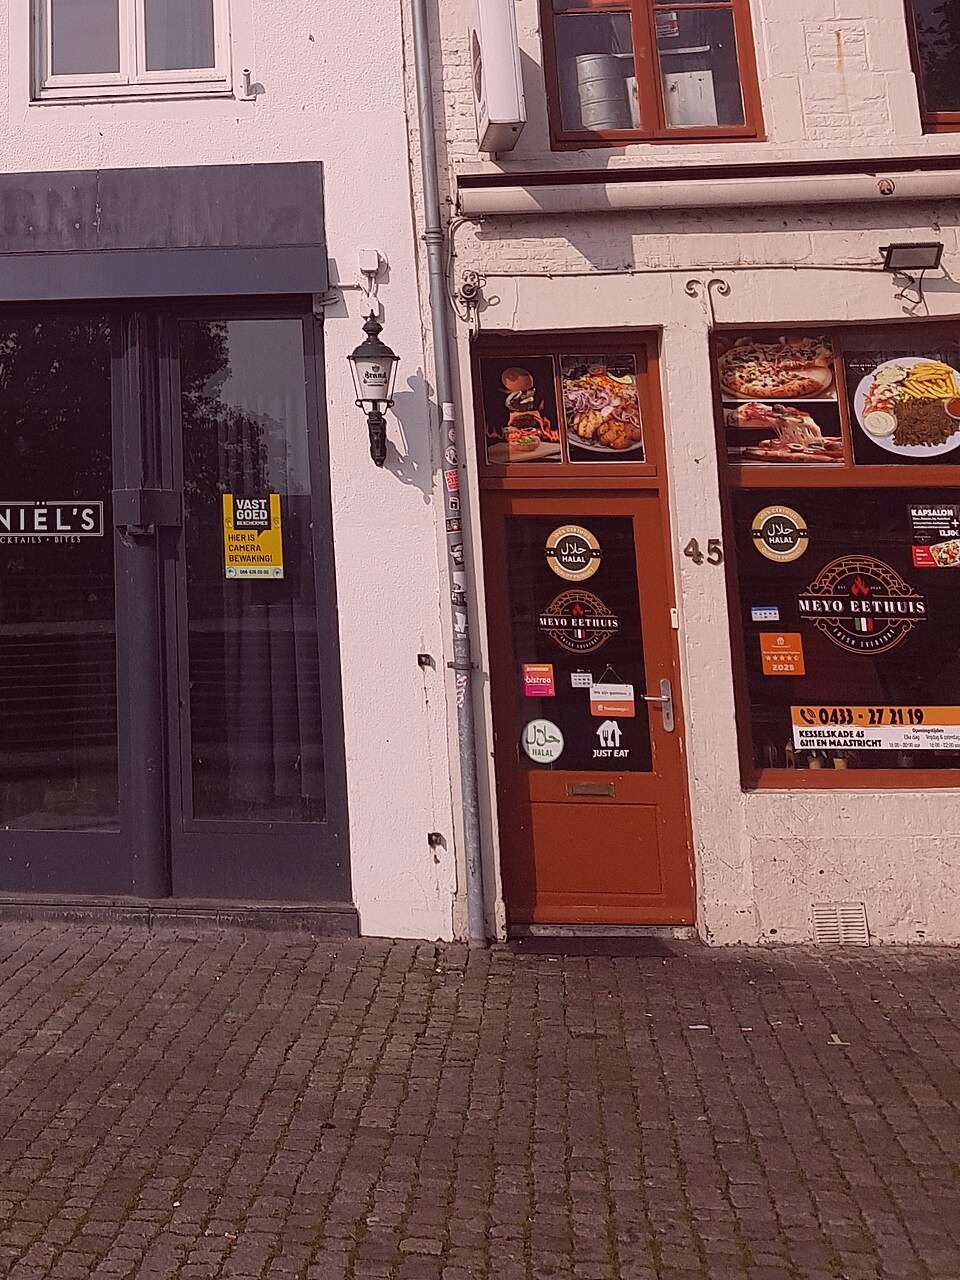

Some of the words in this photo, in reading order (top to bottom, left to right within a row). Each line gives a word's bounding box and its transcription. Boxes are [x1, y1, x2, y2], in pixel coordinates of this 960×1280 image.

[236, 499, 267, 510] VAST
[236, 509, 268, 520] GOED
[911, 509, 954, 517] KAPSALON
[767, 523, 794, 536] حلال
[54, 536, 81, 544] BITES
[228, 533, 246, 542] HIER
[247, 533, 255, 541] IS
[768, 536, 794, 544] HALAL
[228, 544, 262, 552] CAMERA
[560, 542, 587, 555] حلال
[683, 537, 723, 566] 45
[229, 554, 273, 562] BEWAKING!
[561, 555, 586, 563] HALAL
[799, 600, 843, 613] MEYO
[850, 601, 926, 614] EETHUIS
[540, 617, 568, 627] MEYO
[571, 618, 619, 628] EETHUIS
[524, 675, 552, 684] bistroo
[818, 708, 854, 725] 0433
[868, 708, 884, 725] 27
[889, 708, 904, 725] 21
[907, 708, 924, 725] 19
[798, 730, 854, 738] KESSELSKADE
[855, 730, 865, 738] 45
[800, 739, 815, 747] 6211
[816, 739, 827, 747] EN
[828, 739, 882, 747] MAASTRICHT
[531, 748, 554, 757] HALAL
[592, 749, 612, 758] JUST
[613, 750, 630, 758] EAT
